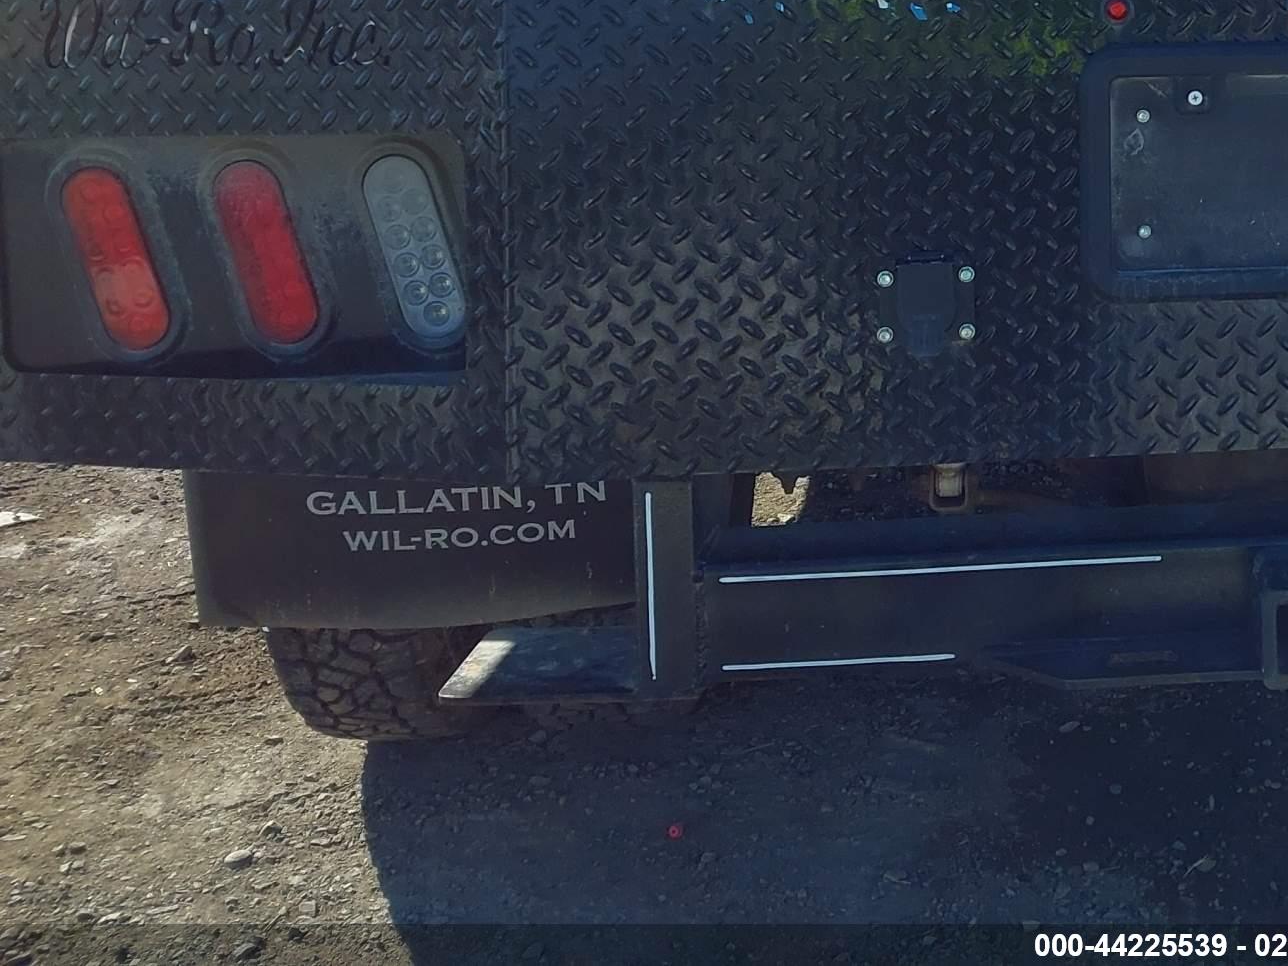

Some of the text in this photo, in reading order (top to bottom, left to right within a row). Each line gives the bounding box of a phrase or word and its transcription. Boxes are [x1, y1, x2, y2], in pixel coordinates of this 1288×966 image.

[305, 480, 607, 516] GALLATIN, TN
[342, 519, 577, 552] WIL-RO.COM
